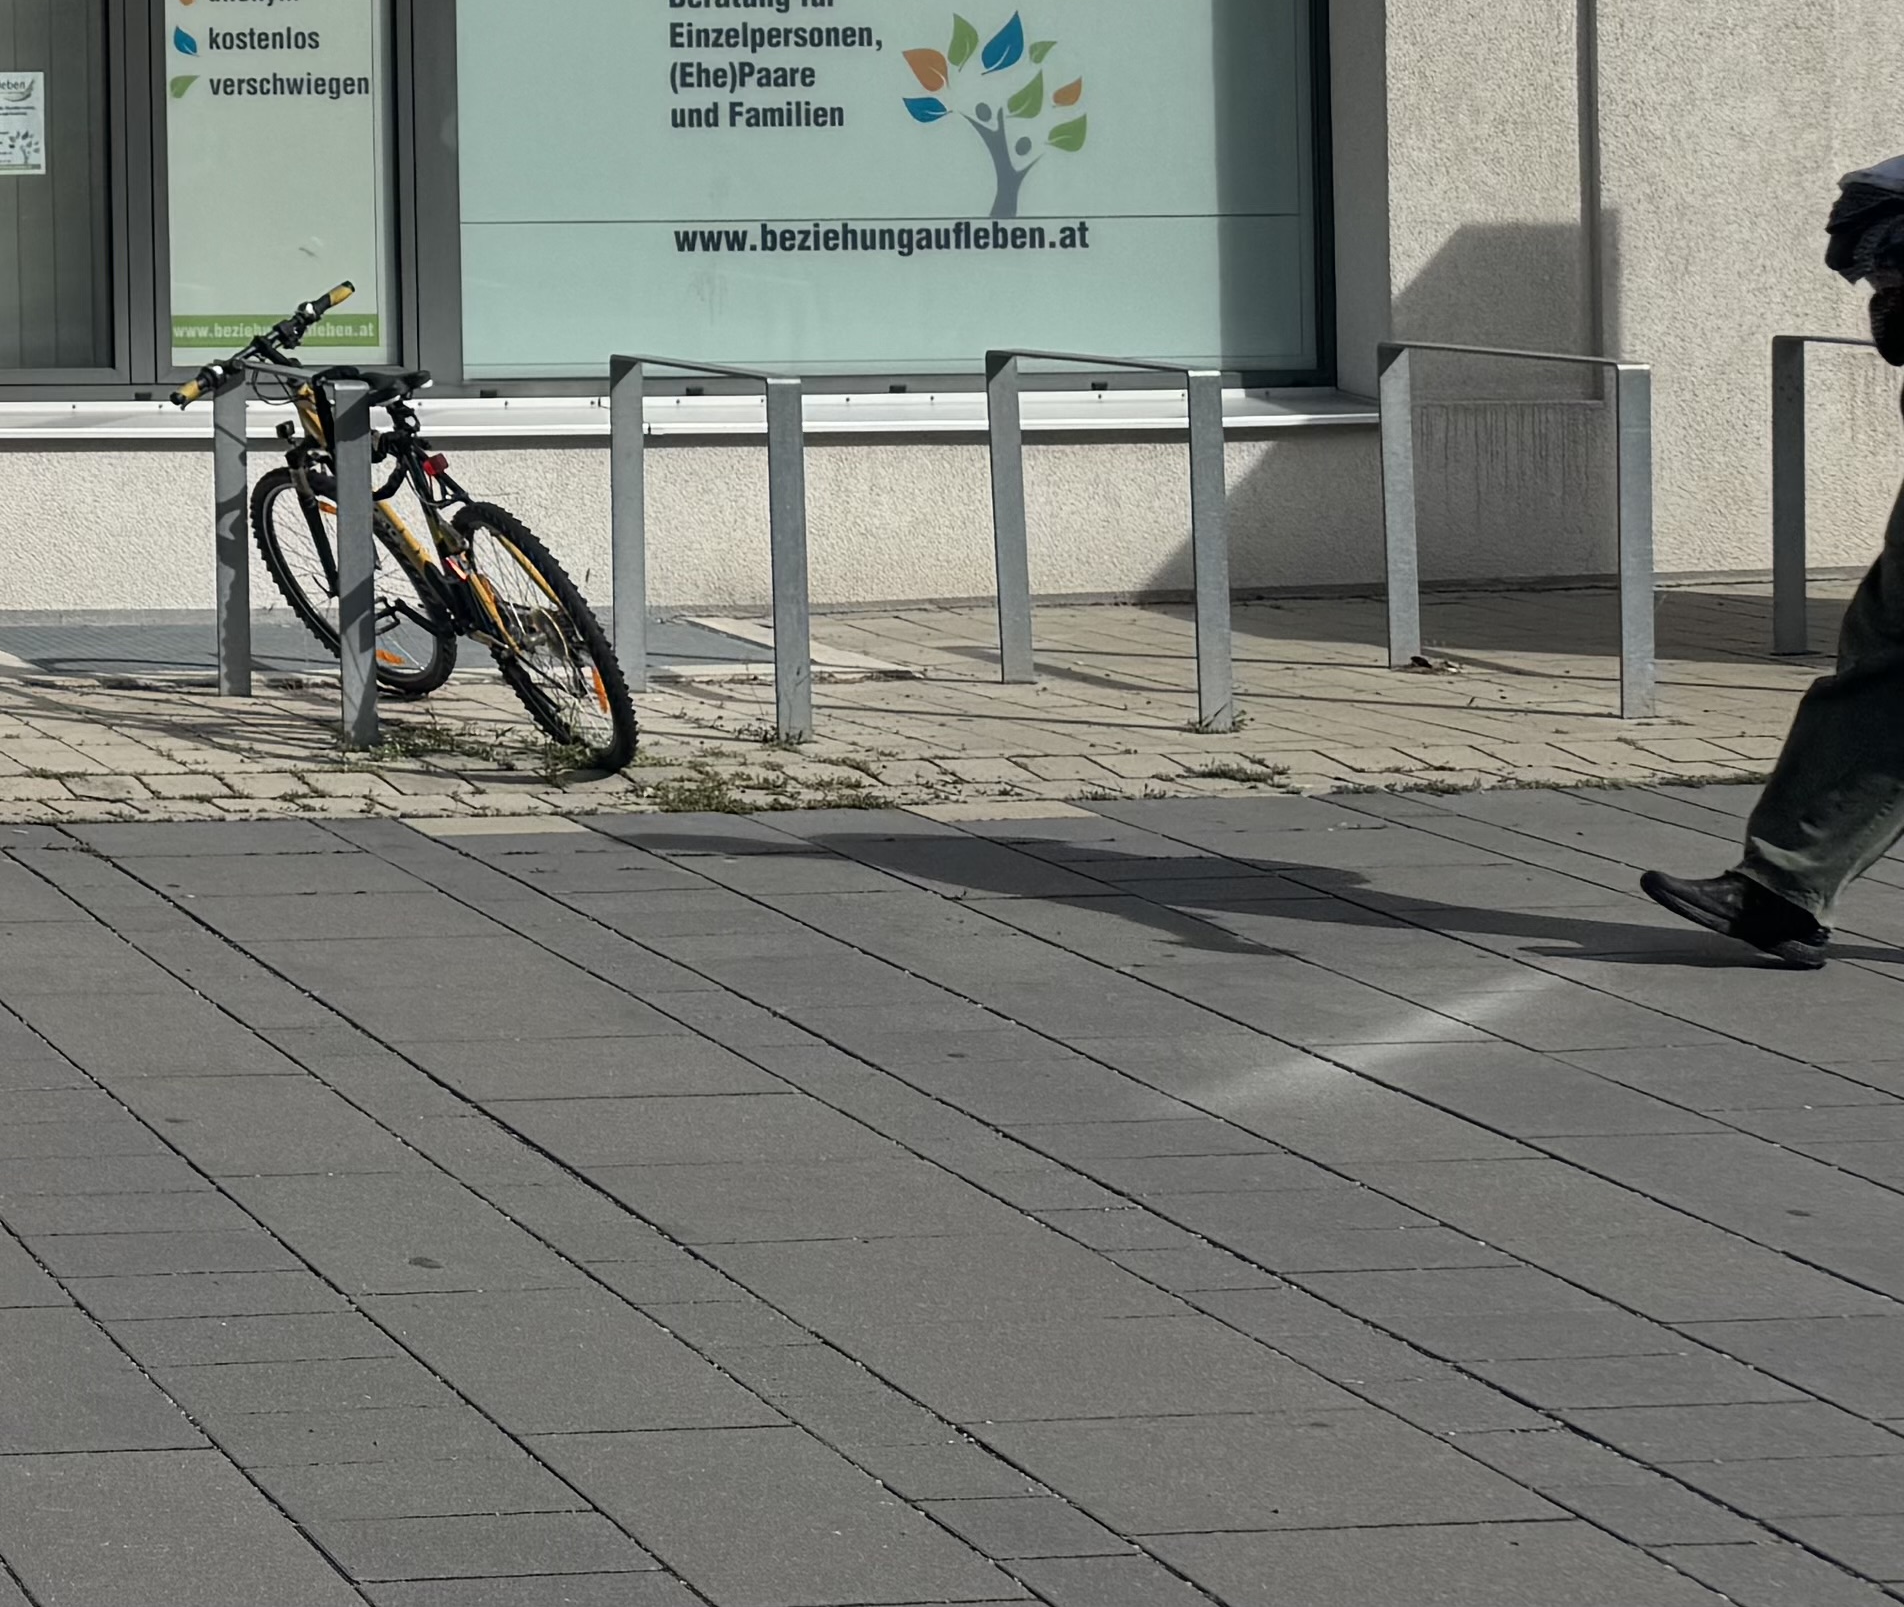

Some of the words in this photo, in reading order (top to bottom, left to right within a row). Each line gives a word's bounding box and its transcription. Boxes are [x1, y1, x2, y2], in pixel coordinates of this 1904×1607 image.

[208, 26, 320, 50] kostenlos
[668, 22, 883, 54] Einzelpersonen,
[209, 72, 370, 100] verschwiegen
[669, 60, 816, 94] (Ehe)Paare
[670, 102, 719, 129] und
[729, 101, 845, 128] Familien
[674, 221, 1090, 257] www.beziehungaufleben.at
[173, 321, 375, 339] www.beziehleben.at
